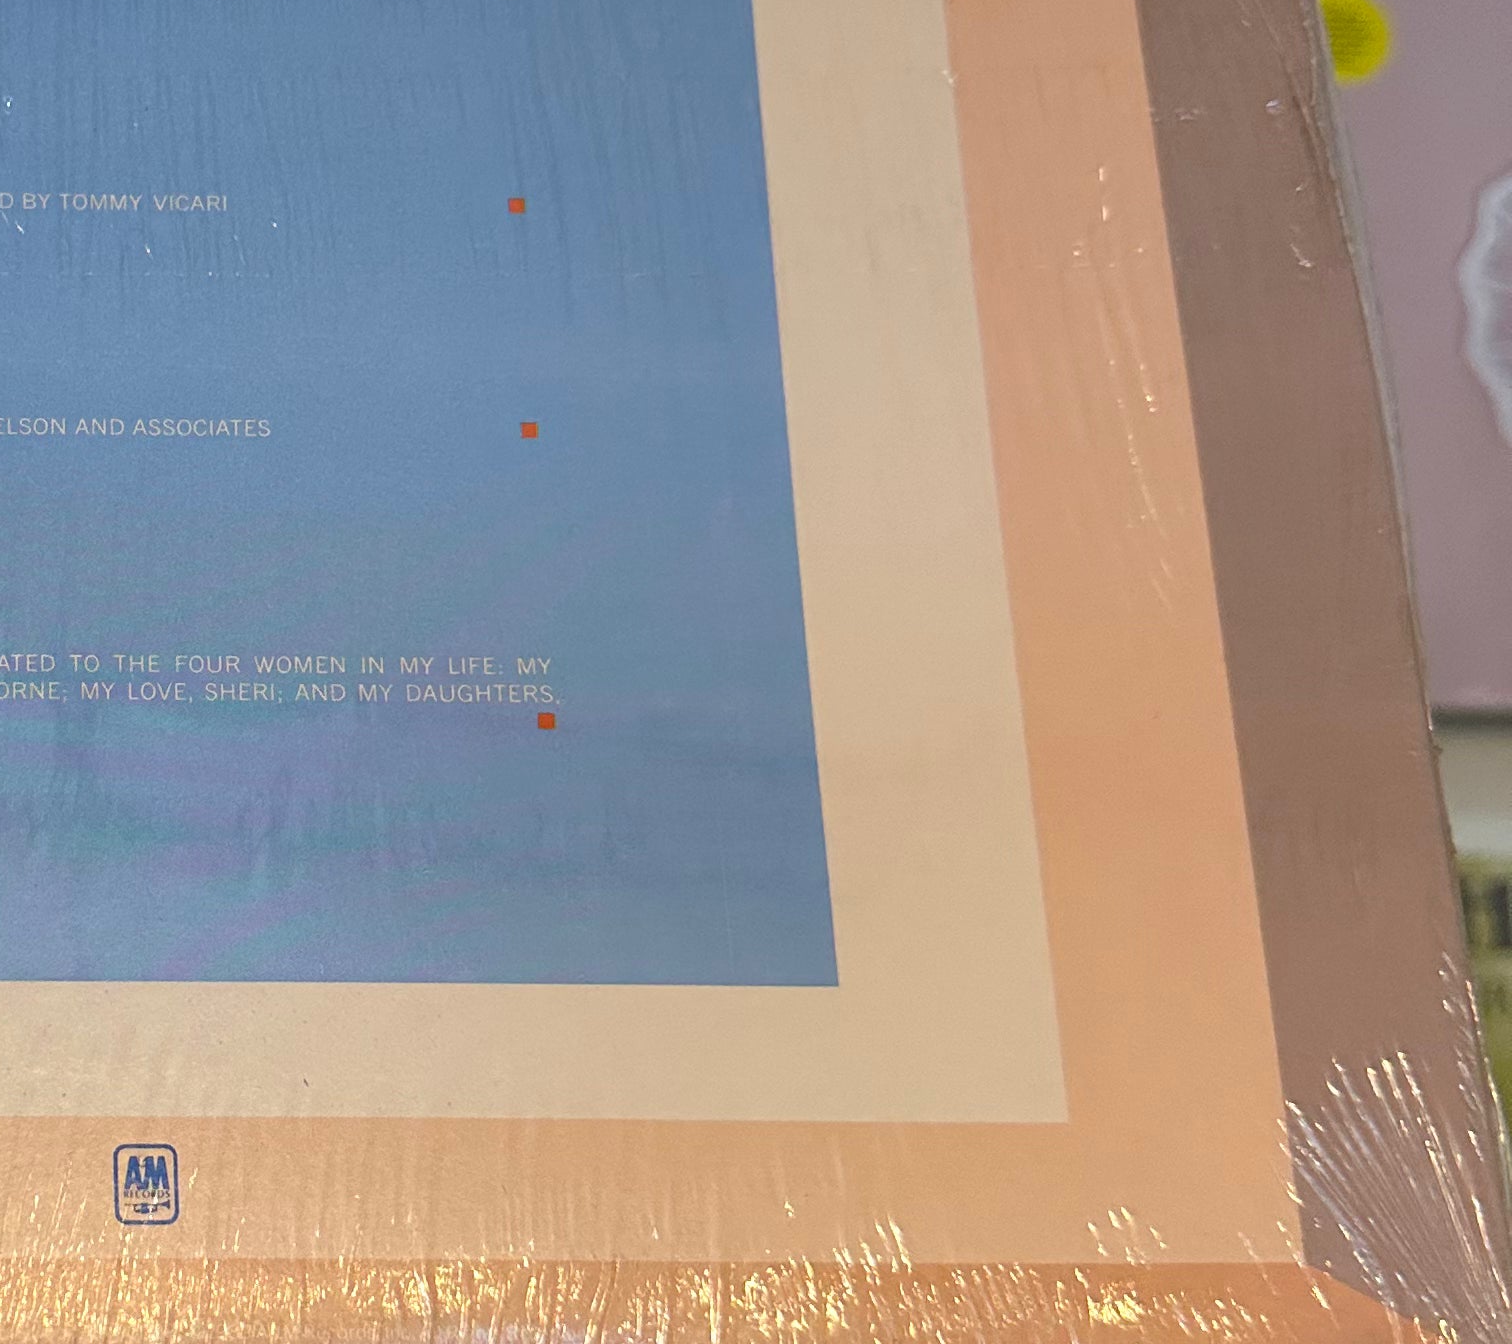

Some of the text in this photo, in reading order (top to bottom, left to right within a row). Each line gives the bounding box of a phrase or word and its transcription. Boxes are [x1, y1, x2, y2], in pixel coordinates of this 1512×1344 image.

[22, 192, 51, 210] BY
[60, 192, 142, 211] TOMMY
[153, 193, 229, 213] VICARI
[74, 417, 126, 437] AND
[132, 418, 273, 438] ASSOCIATES
[70, 654, 101, 673] TO
[113, 654, 161, 674] THE
[174, 654, 242, 674] FOUR
[253, 655, 347, 675] WOMEN
[361, 655, 385, 675] IN
[399, 656, 435, 675] MY
[516, 657, 552, 676] MY
[80, 682, 116, 701] MY
[128, 682, 194, 704] LOVE,
[294, 683, 347, 703] AND
[358, 684, 392, 703] MY
